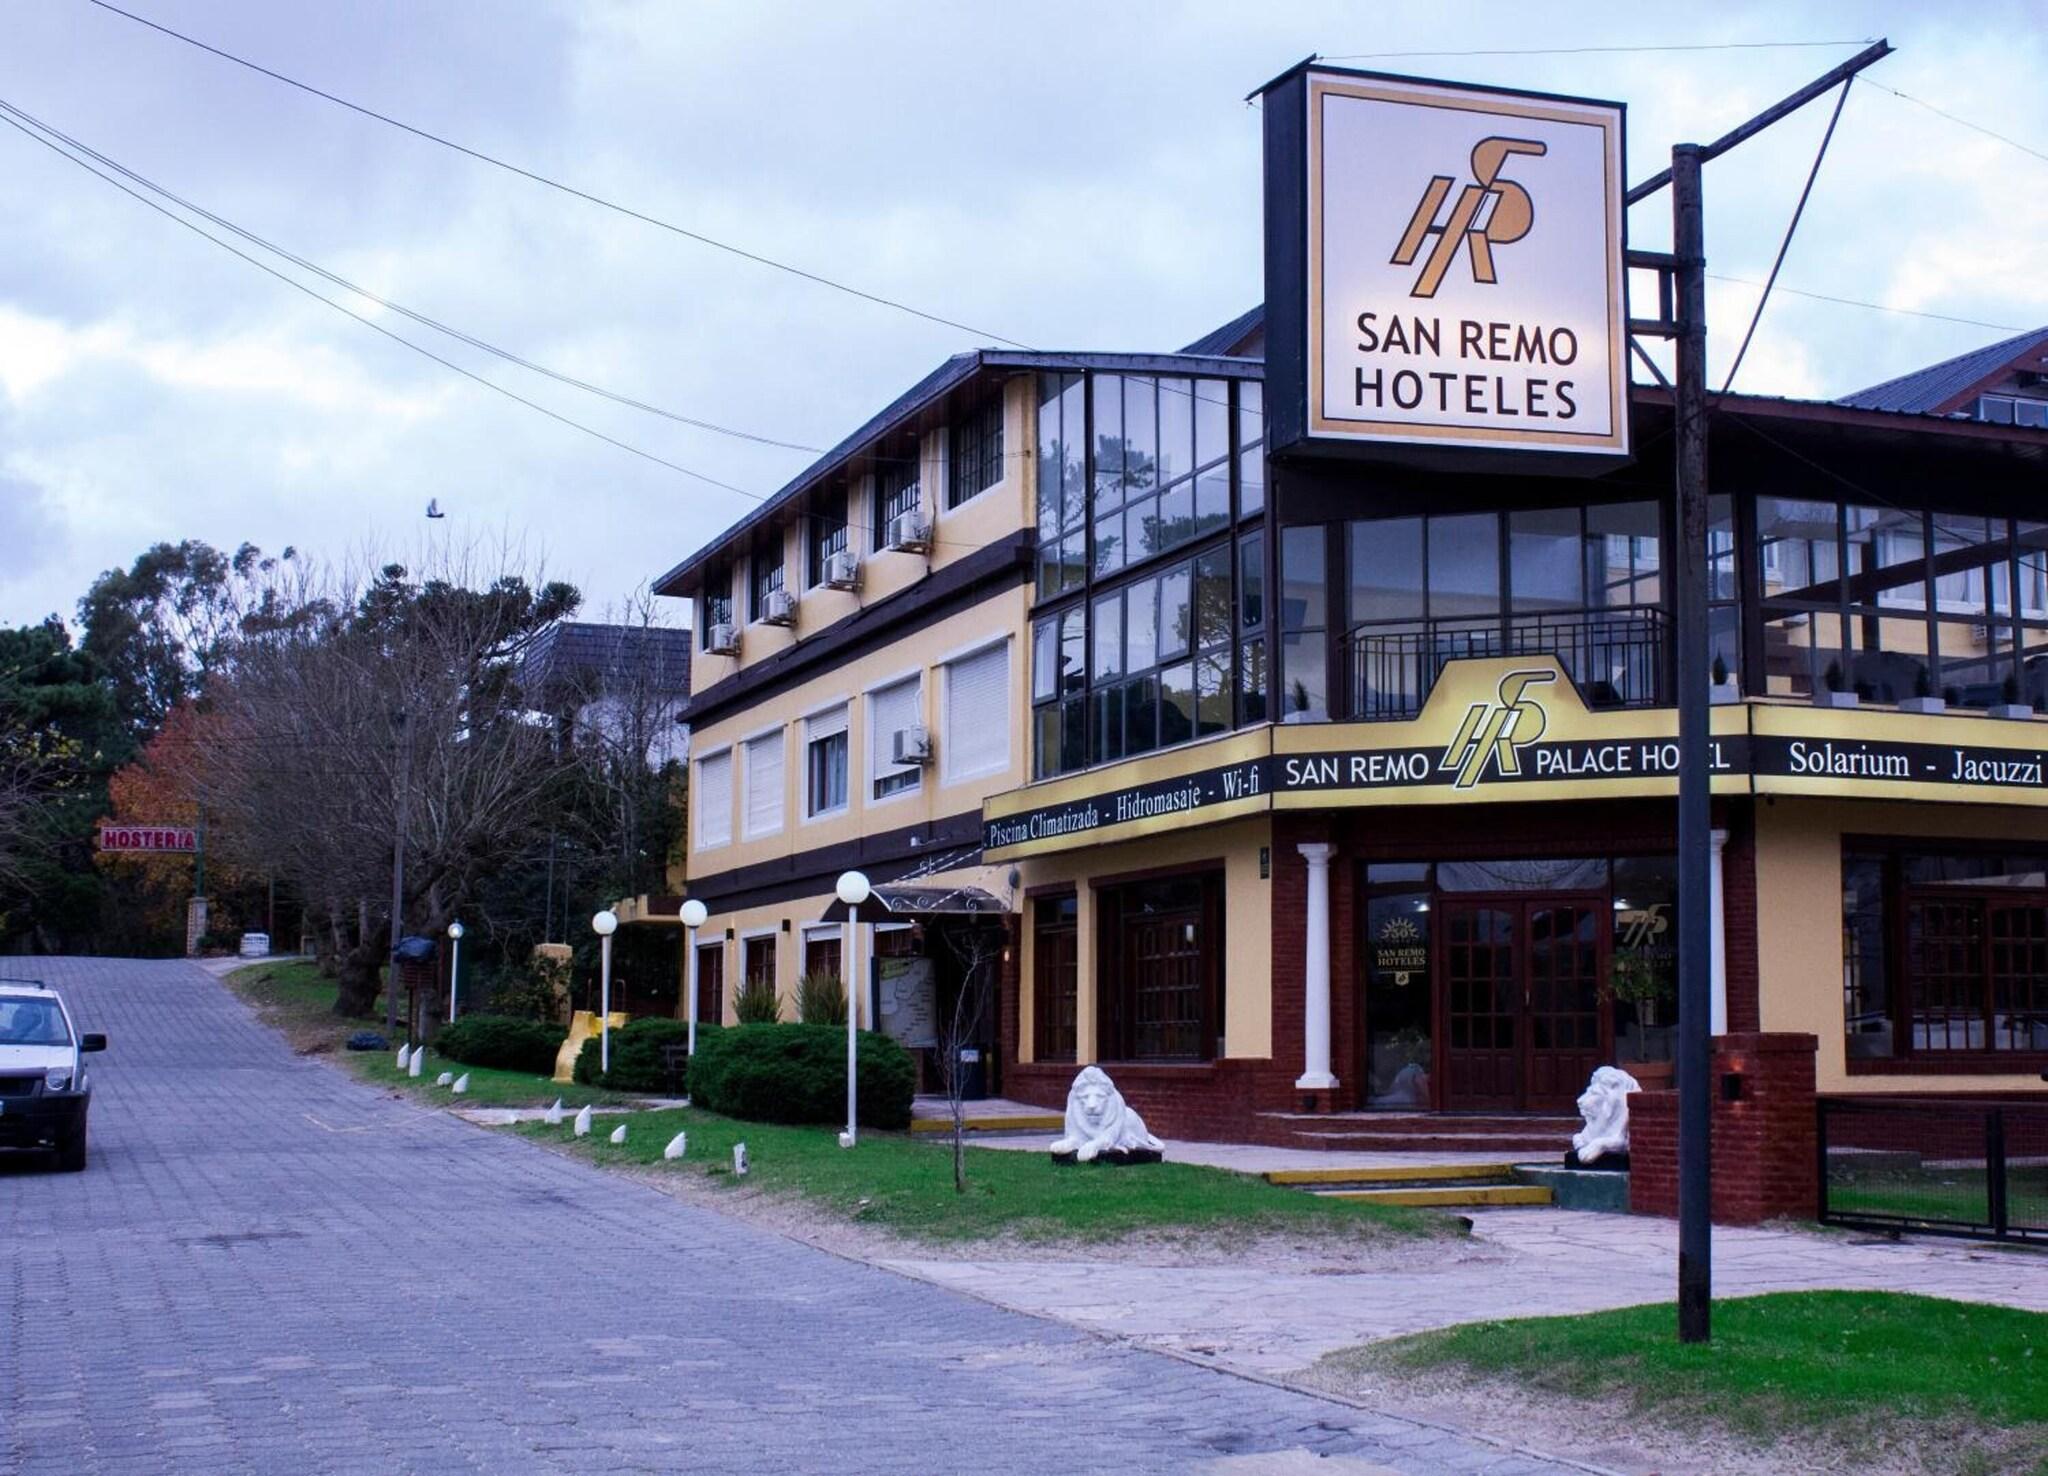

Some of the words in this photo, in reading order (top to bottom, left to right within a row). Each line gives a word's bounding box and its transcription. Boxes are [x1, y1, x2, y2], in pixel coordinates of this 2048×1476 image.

[1357, 312, 1440, 357] SAN
[1460, 319, 1578, 366] REMO
[1355, 367, 1577, 419] HOTELES
[1286, 758, 1339, 785] SAN
[1351, 753, 1429, 783] REMO
[1537, 746, 1631, 774] PALACE
[1642, 742, 1731, 770] HOL
[1789, 742, 1910, 776] Solarium
[1952, 750, 2043, 784] Jacuzzi
[990, 819, 1028, 848] Piscina
[1030, 803, 1098, 838] Climatizada
[1117, 781, 1200, 821] Hidromasaje
[1222, 765, 1259, 800] Wi-fi
[104, 831, 196, 849] HOSTERIA
[1377, 949, 1396, 957] SAN
[1398, 948, 1425, 957] REMO
[1378, 957, 1426, 966] HOTELES
